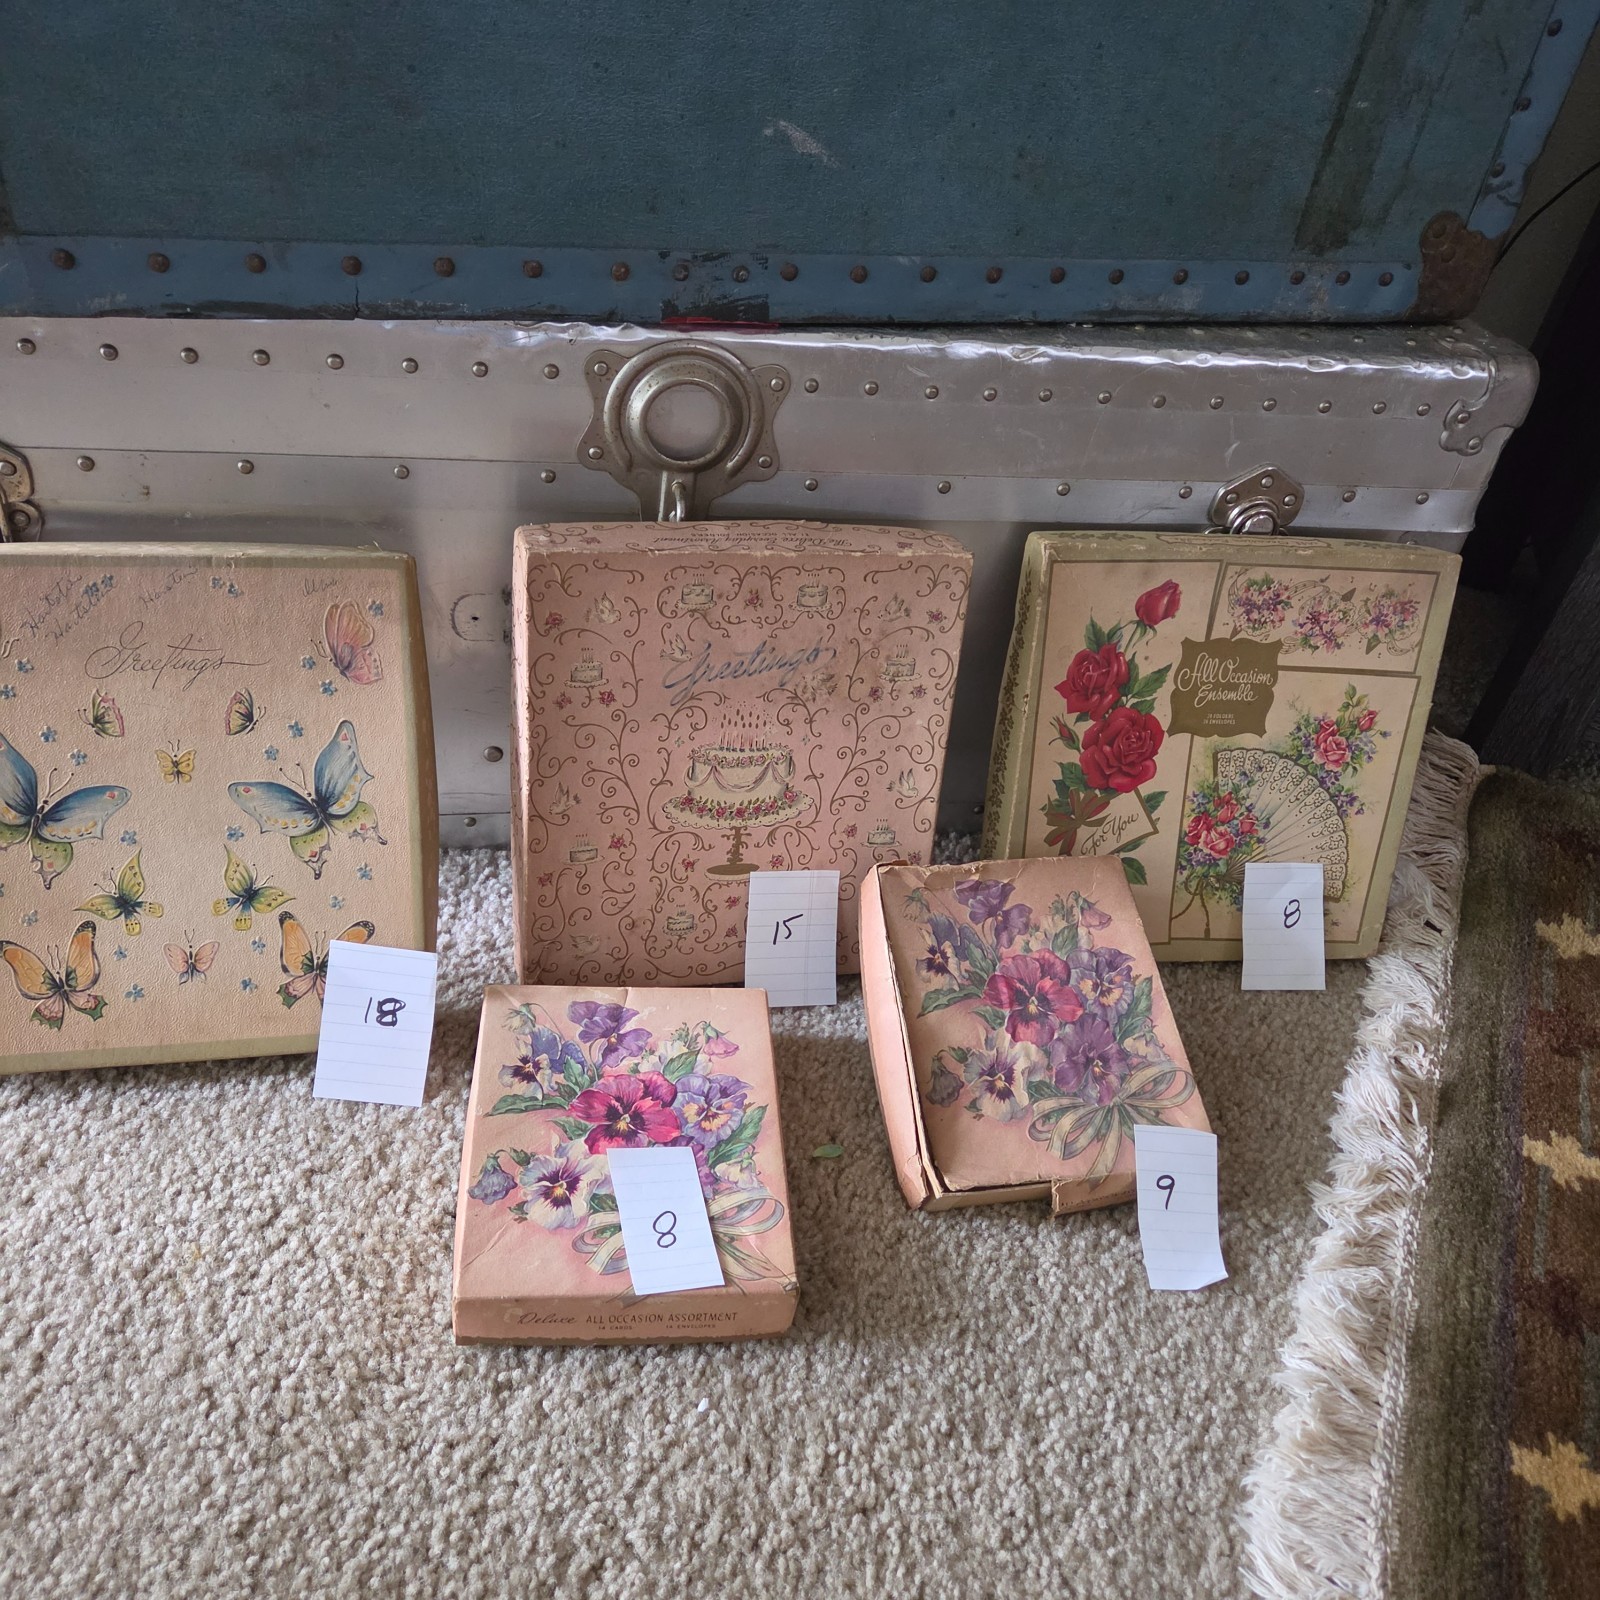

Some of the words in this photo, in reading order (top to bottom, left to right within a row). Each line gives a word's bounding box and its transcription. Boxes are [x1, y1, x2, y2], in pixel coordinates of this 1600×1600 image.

[782, 537, 827, 547] Deluxe
[84, 620, 273, 690] Greetings
[662, 636, 838, 706] Greetings
[1177, 652, 1219, 691] All
[1218, 656, 1274, 685] Occasion
[1194, 683, 1260, 708] Ensemble
[1080, 828, 1107, 856] For
[1102, 813, 1139, 843] You
[772, 913, 804, 945] 15
[1283, 898, 1301, 929] 8
[364, 996, 407, 1028] 18
[1156, 1174, 1176, 1210] 9
[652, 1210, 677, 1248] 8
[517, 1312, 577, 1325] Deluxe
[586, 1315, 604, 1324] ALL
[608, 1314, 663, 1324] OCCASION
[668, 1312, 737, 1322] ASSORTMENT
